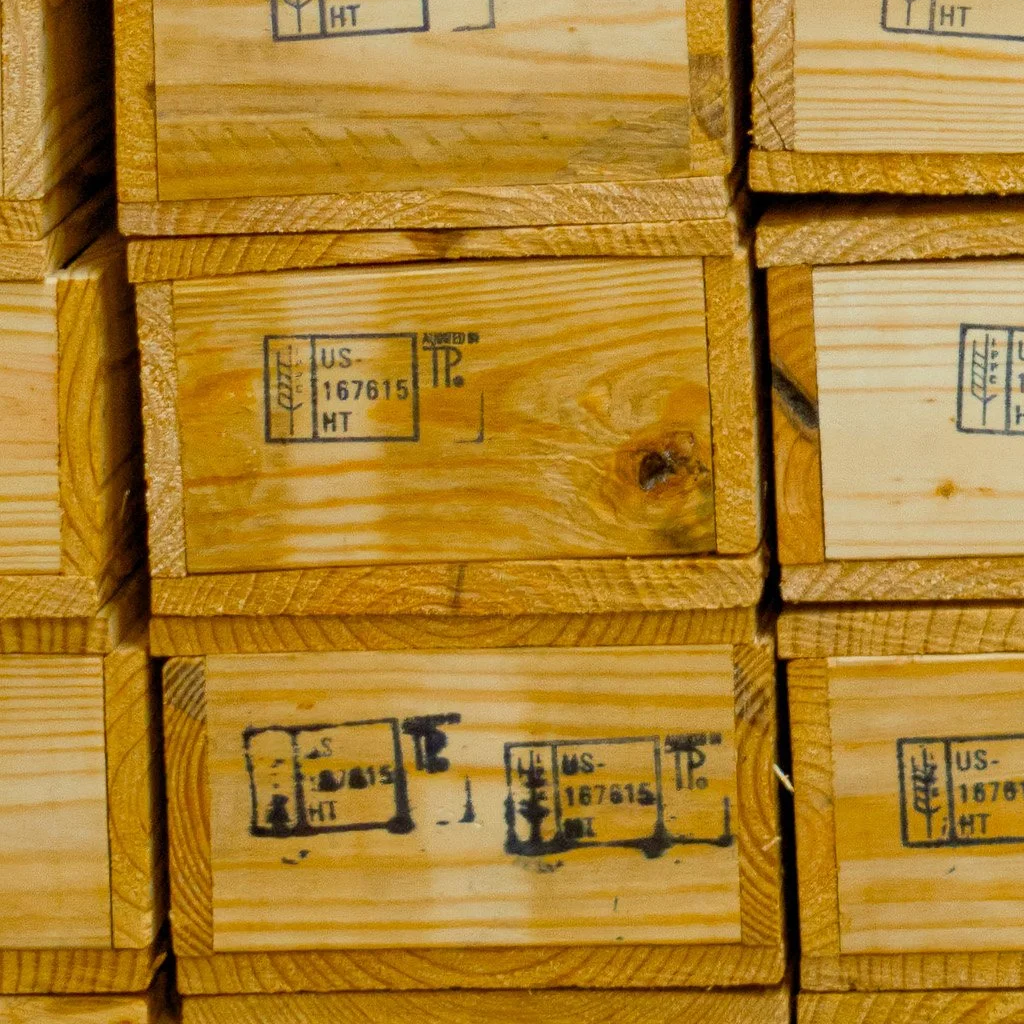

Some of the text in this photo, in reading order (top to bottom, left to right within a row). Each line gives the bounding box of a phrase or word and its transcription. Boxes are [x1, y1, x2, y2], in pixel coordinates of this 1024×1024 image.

[330, 4, 360, 28] HT
[940, 5, 971, 27] HT
[321, 348, 362, 368] US-
[324, 380, 409, 400] 167615
[323, 412, 352, 432] HT
[562, 752, 606, 776] US-
[955, 750, 1000, 771] US-
[309, 800, 337, 822] HT
[959, 813, 990, 834] HT
